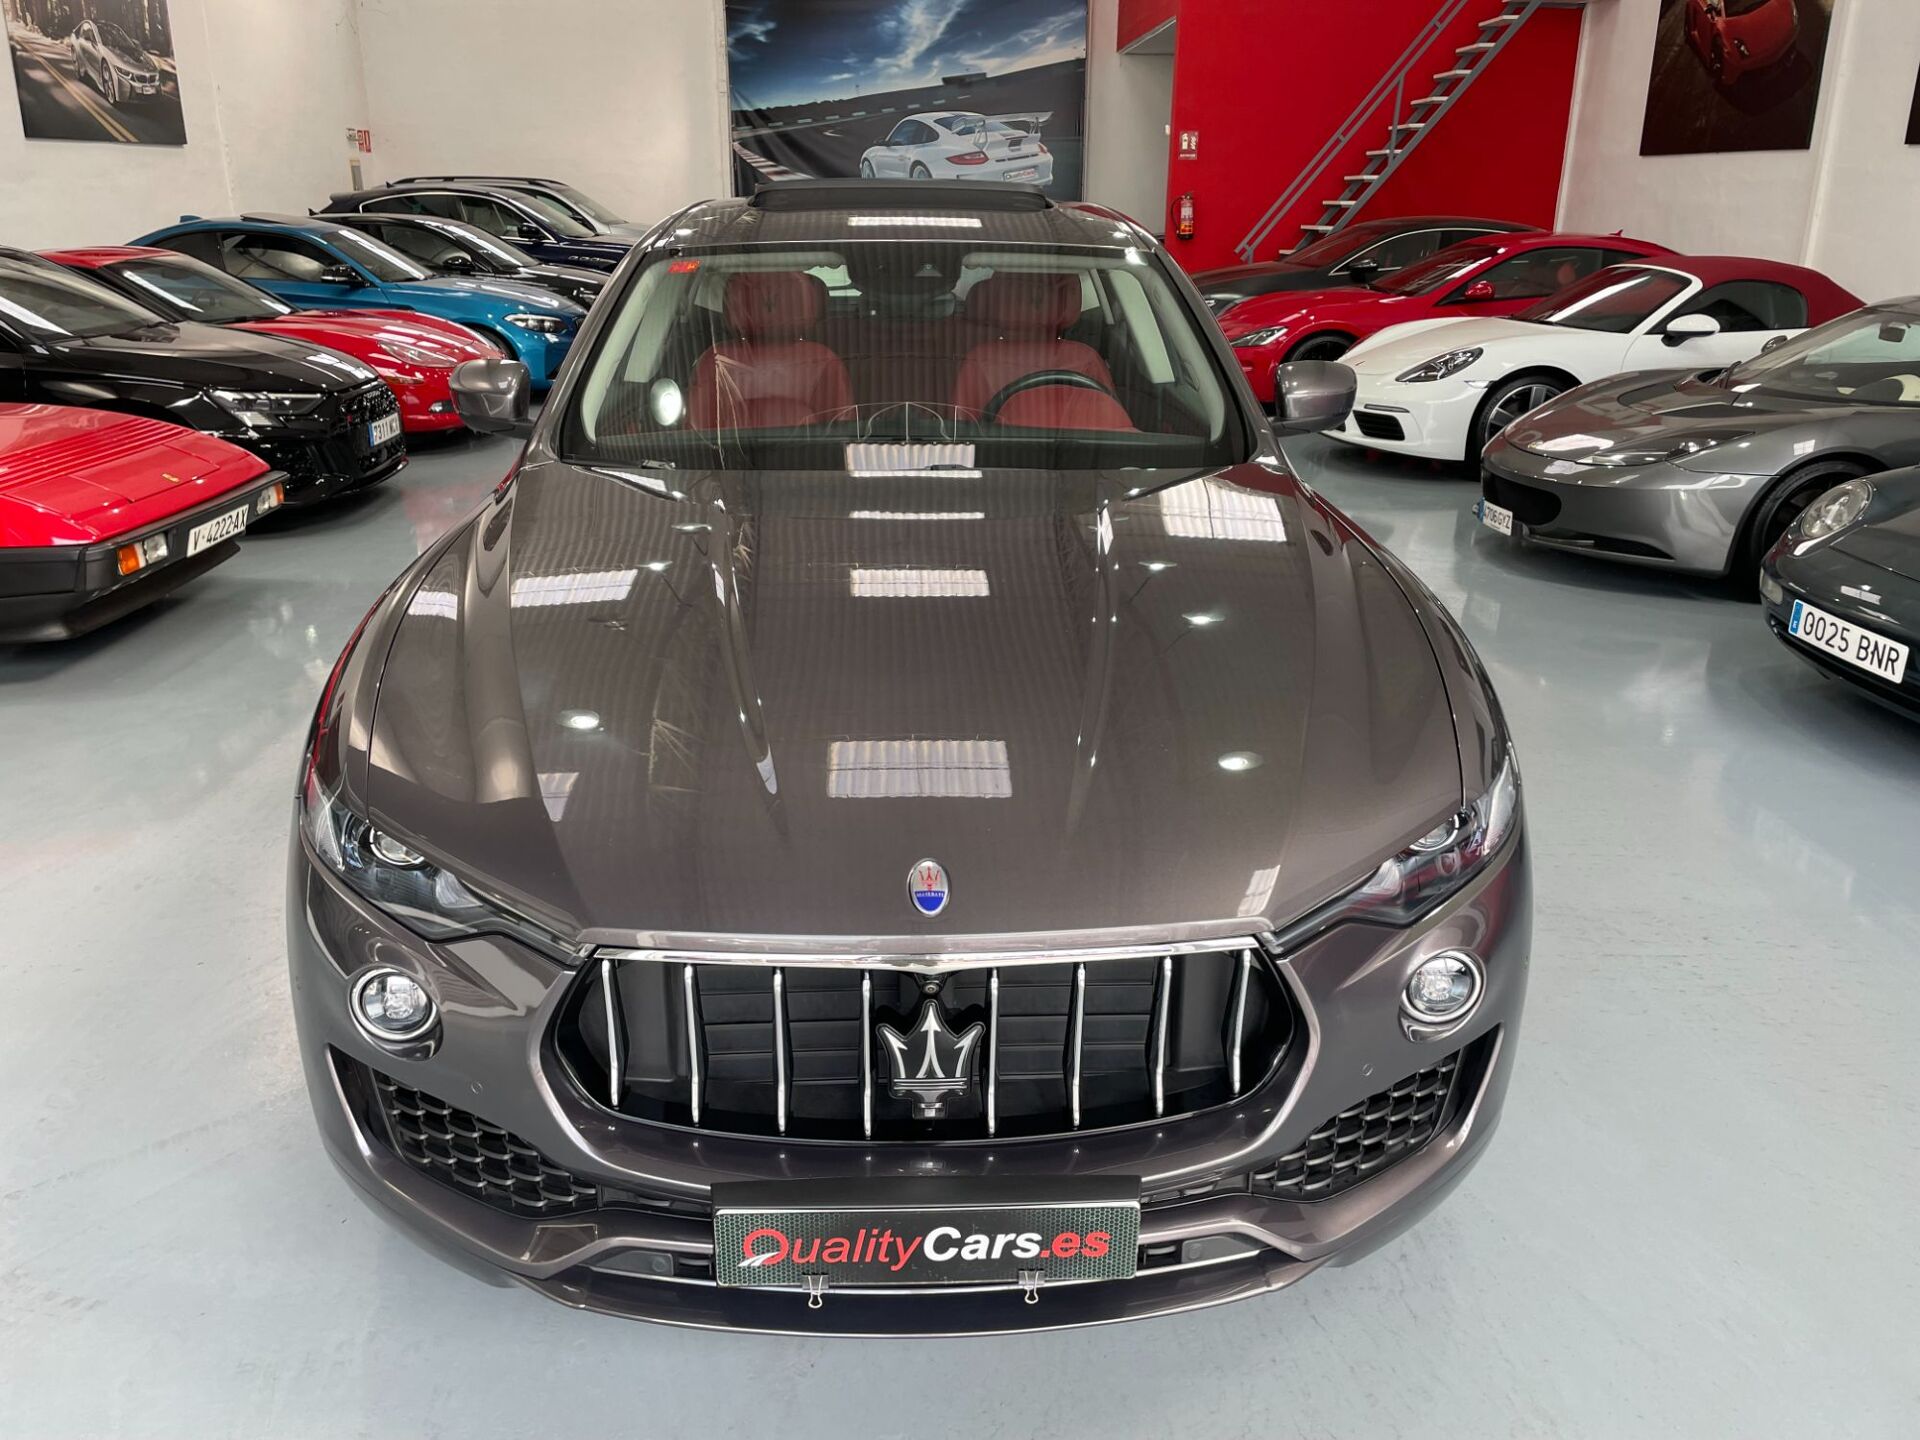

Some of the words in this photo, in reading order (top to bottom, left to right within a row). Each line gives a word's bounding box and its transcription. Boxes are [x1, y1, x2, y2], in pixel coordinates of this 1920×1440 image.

[1803, 611, 1850, 653] 0025
[1856, 634, 1900, 676] BNR
[739, 1226, 1112, 1272] QualityCars.es
